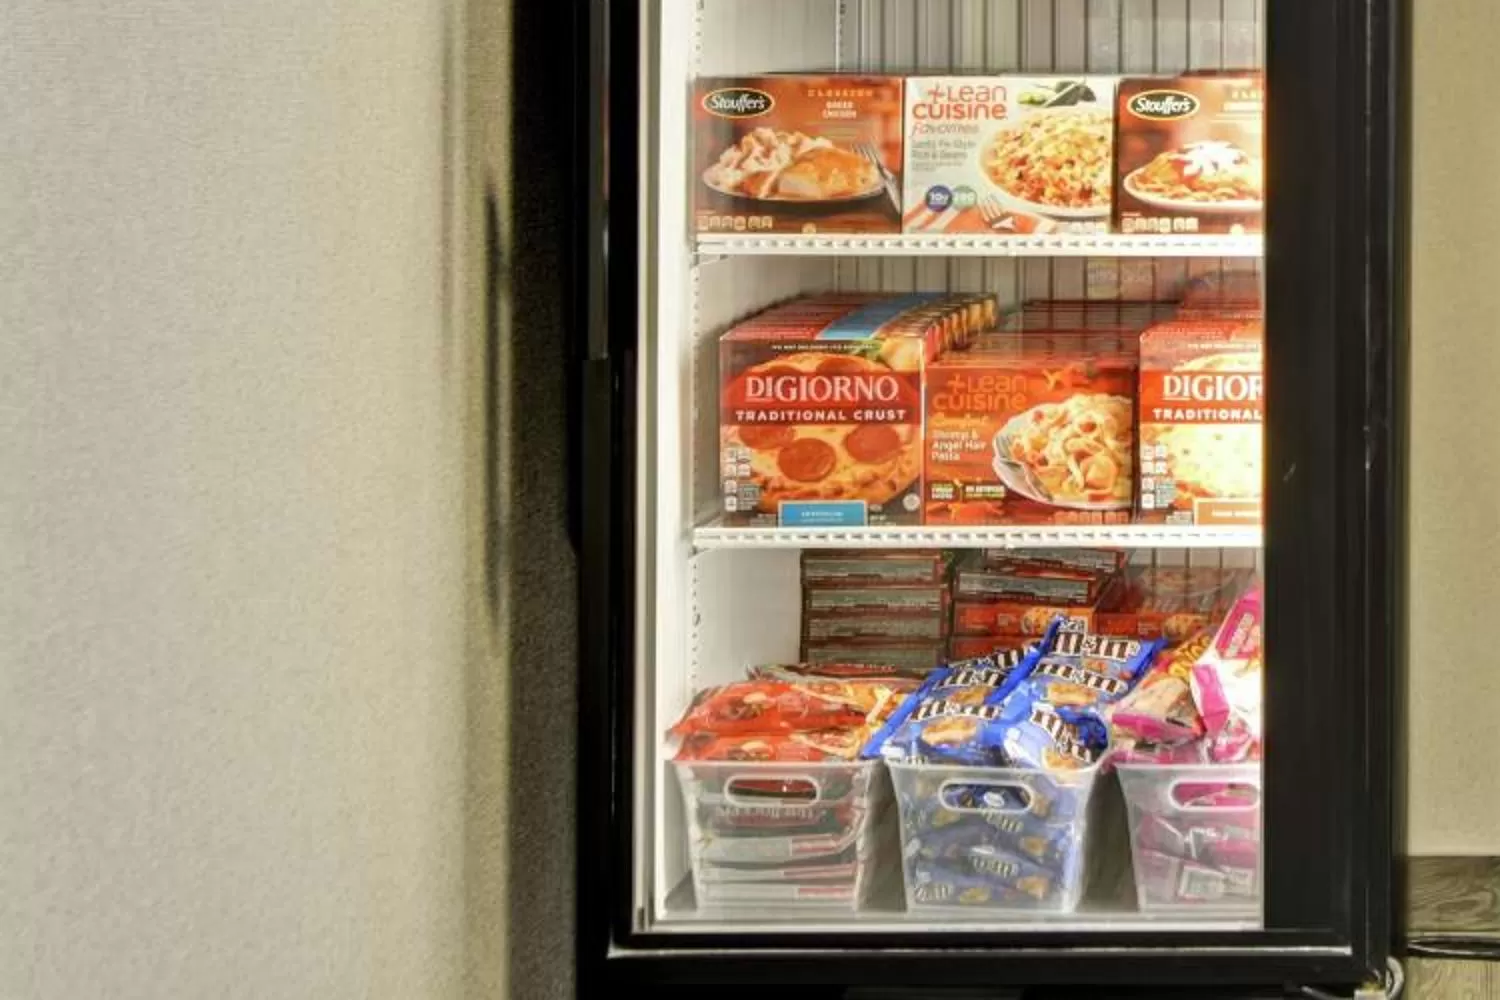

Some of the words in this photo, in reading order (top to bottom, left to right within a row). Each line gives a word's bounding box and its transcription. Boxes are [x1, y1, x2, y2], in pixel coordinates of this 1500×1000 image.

[711, 93, 766, 119] Stouffer's
[1135, 96, 1191, 116] Stouffer's
[735, 409, 847, 421] TRADITIONAL
[853, 409, 906, 421] CRUST
